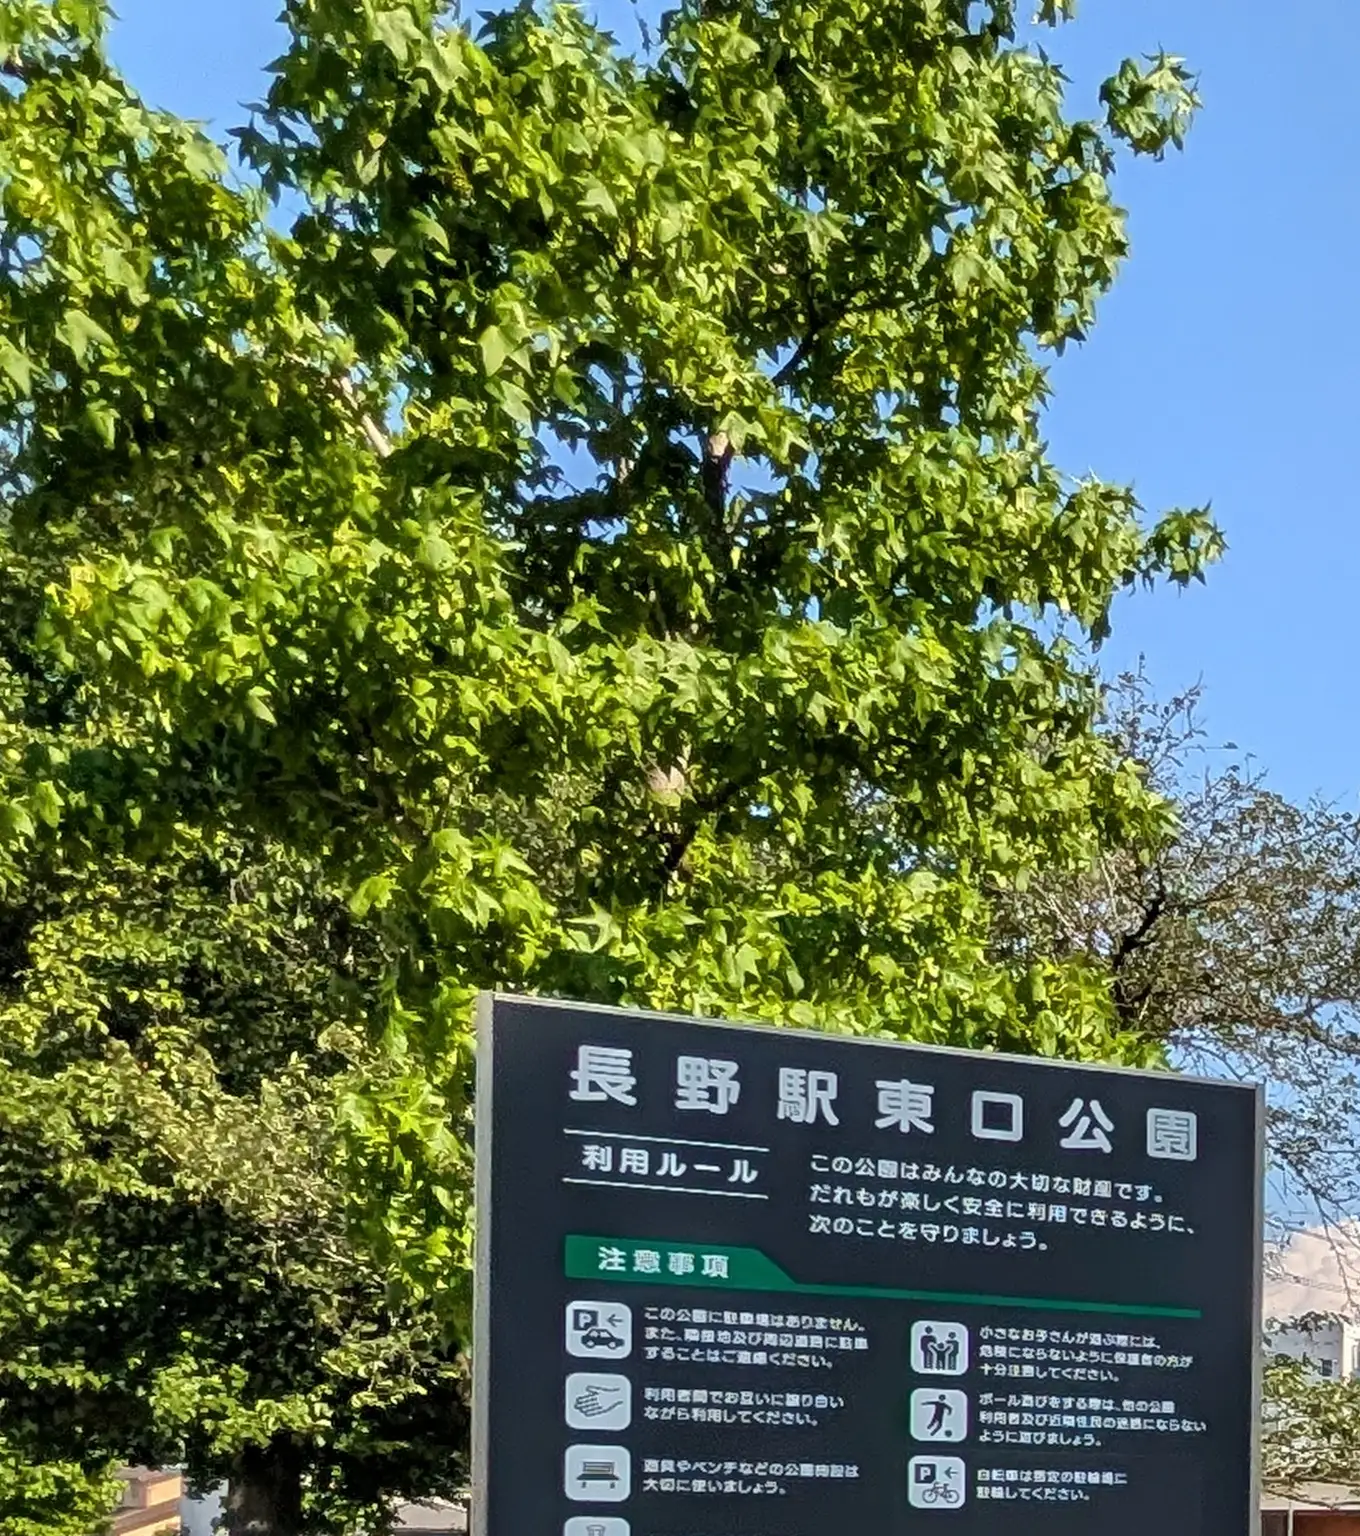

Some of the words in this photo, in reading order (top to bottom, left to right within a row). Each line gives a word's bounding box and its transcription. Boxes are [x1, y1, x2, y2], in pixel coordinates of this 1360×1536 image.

[569, 1044, 1197, 1161] 長野駅東口公園
[581, 1144, 758, 1184] 利用ルール
[811, 1154, 1162, 1203] この公園はみんなの大切な財産です。
[810, 1184, 1194, 1234] だれもが楽しく安全に利用できるように、
[809, 1214, 1048, 1251] 次のことを守りましょう。
[598, 1246, 729, 1279] 注意事項
